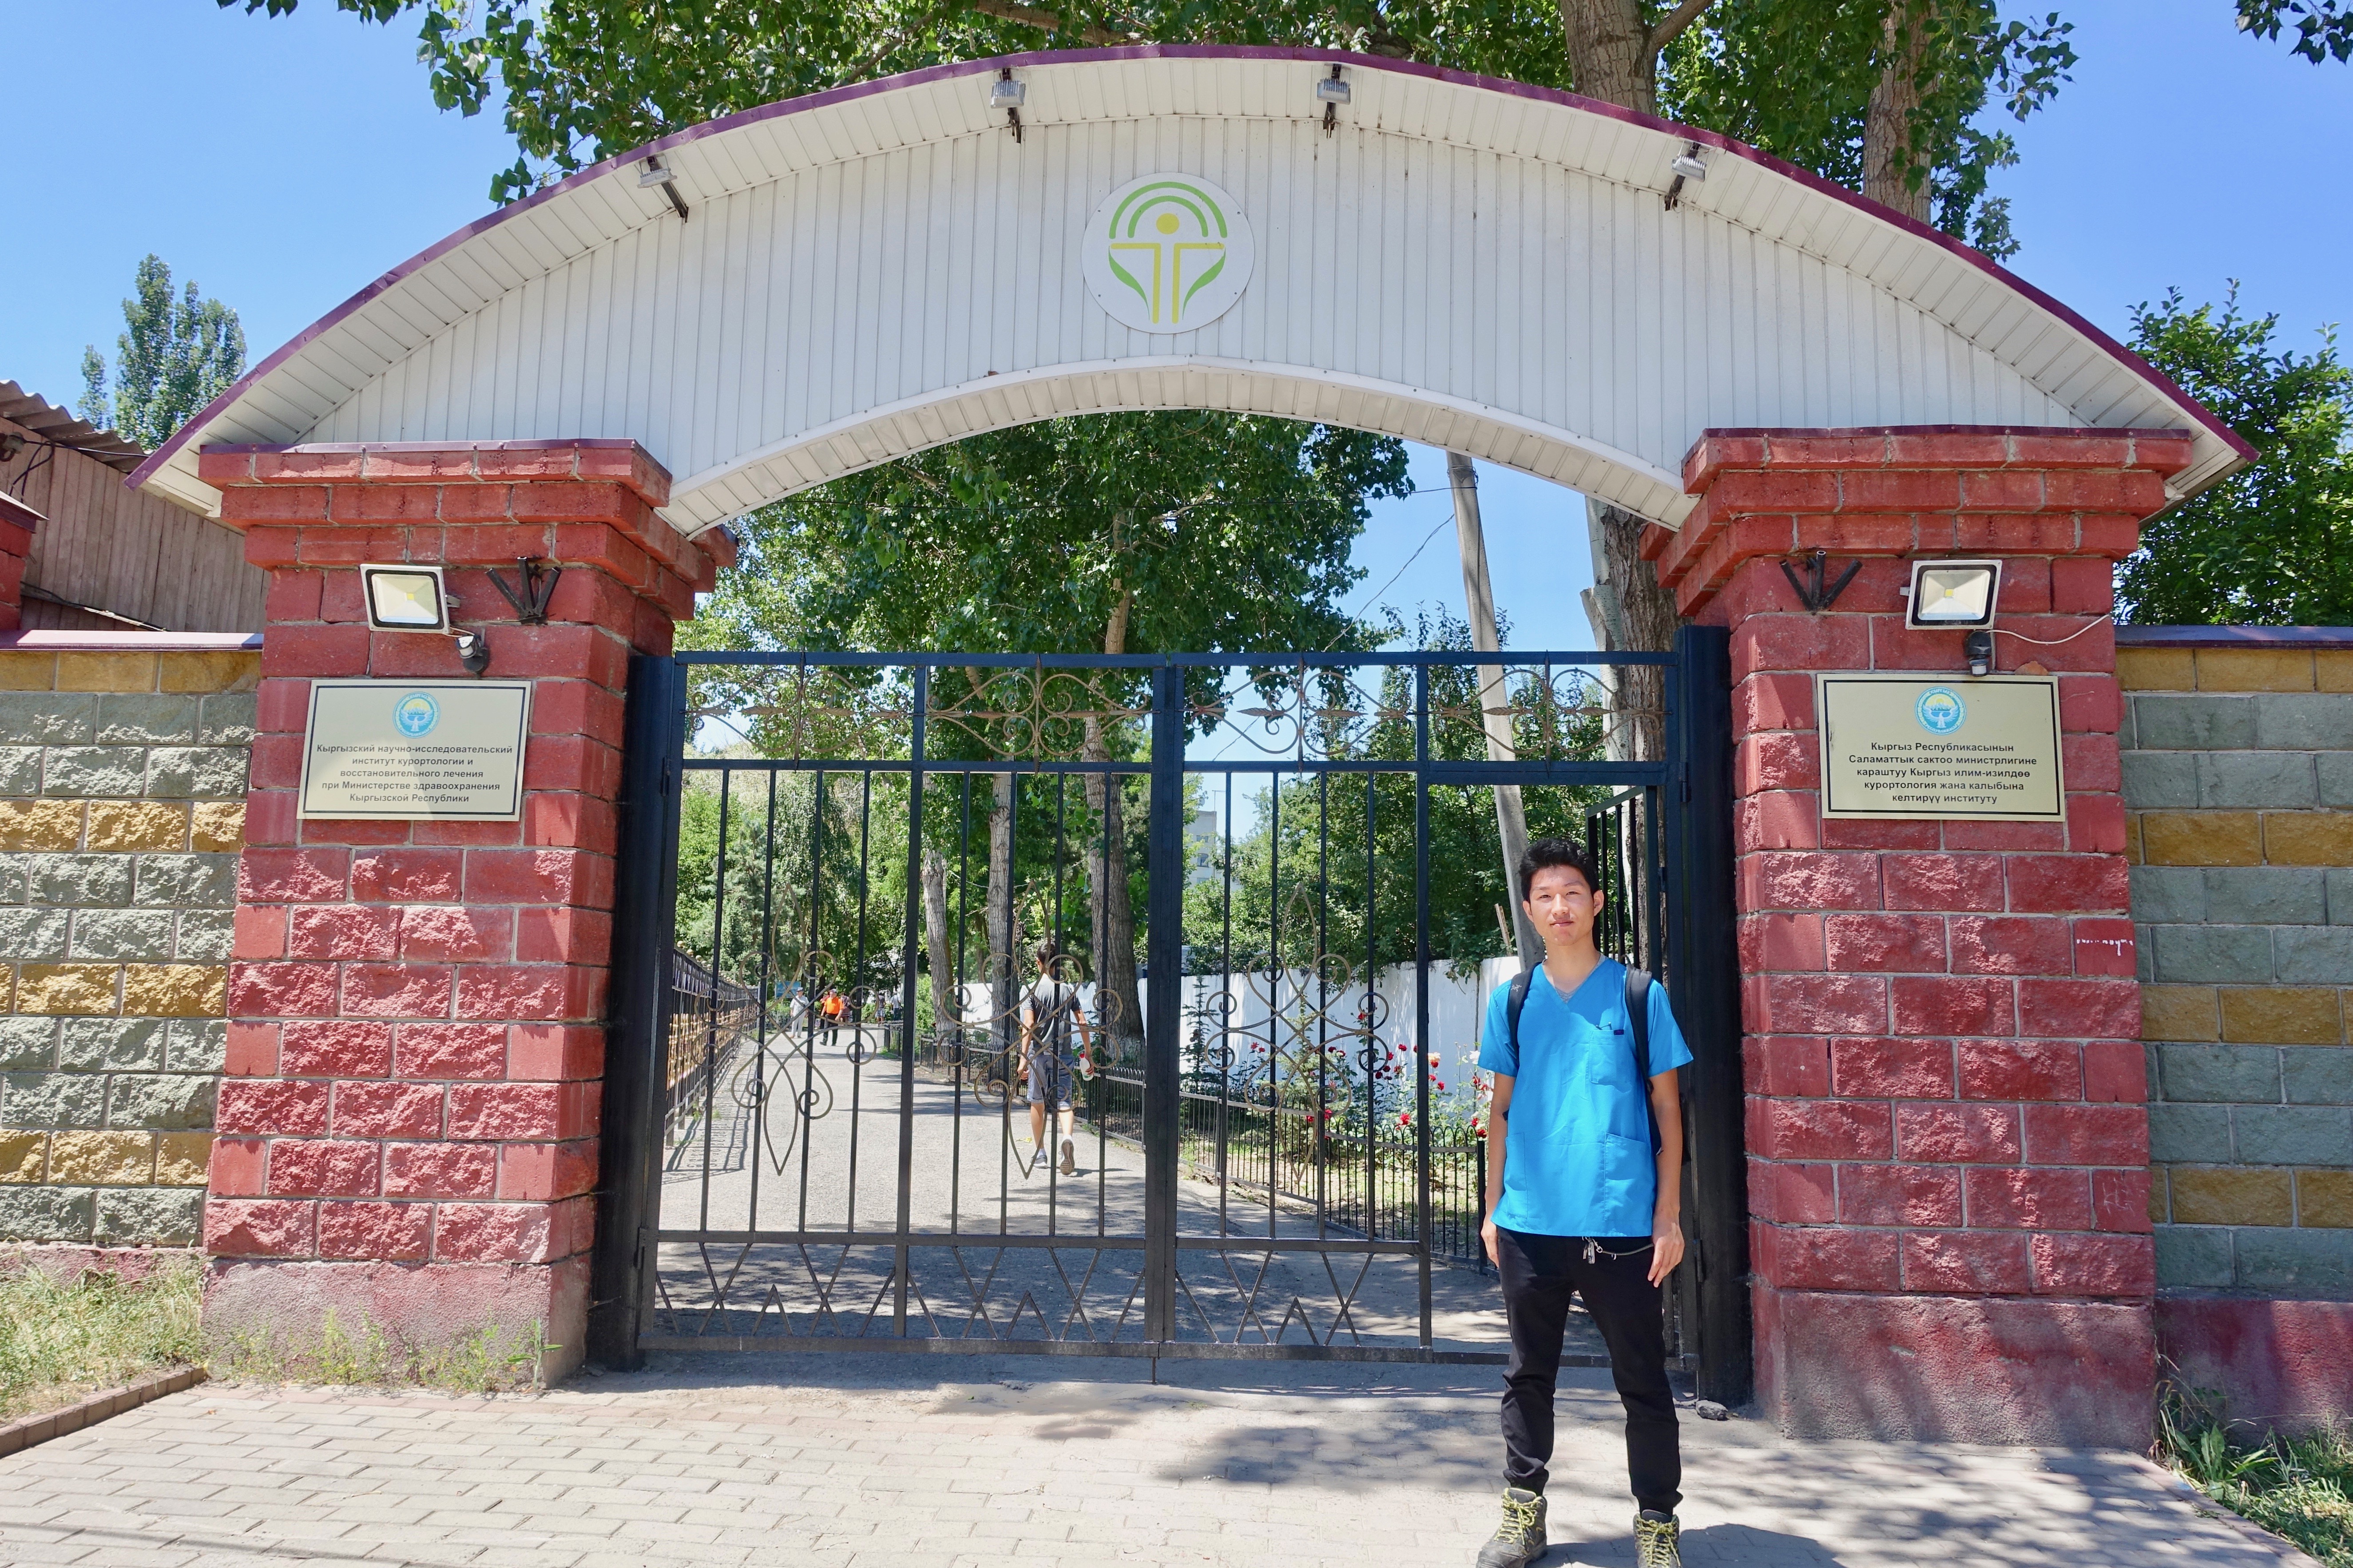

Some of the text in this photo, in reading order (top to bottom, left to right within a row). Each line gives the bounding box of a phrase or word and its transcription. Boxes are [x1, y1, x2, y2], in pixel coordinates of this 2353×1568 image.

[317, 744, 512, 754] Кыргызский научно-исследовательский
[1871, 742, 2014, 753] Кыргыз Республикасынын
[352, 758, 396, 767] институт
[1849, 755, 1914, 763] Саламаттык
[1956, 757, 2037, 766] министрлигине
[1857, 768, 2030, 779] караштуу Кыргыз илим-изилдөө
[342, 781, 411, 791] Министерстве
[413, 783, 500, 792] здравоохранения
[1864, 782, 1936, 791] курортология
[1969, 781, 2024, 790] калыбына
[350, 793, 469, 804] Кыргызской Республики
[1892, 795, 1997, 804] келтирүү институту
